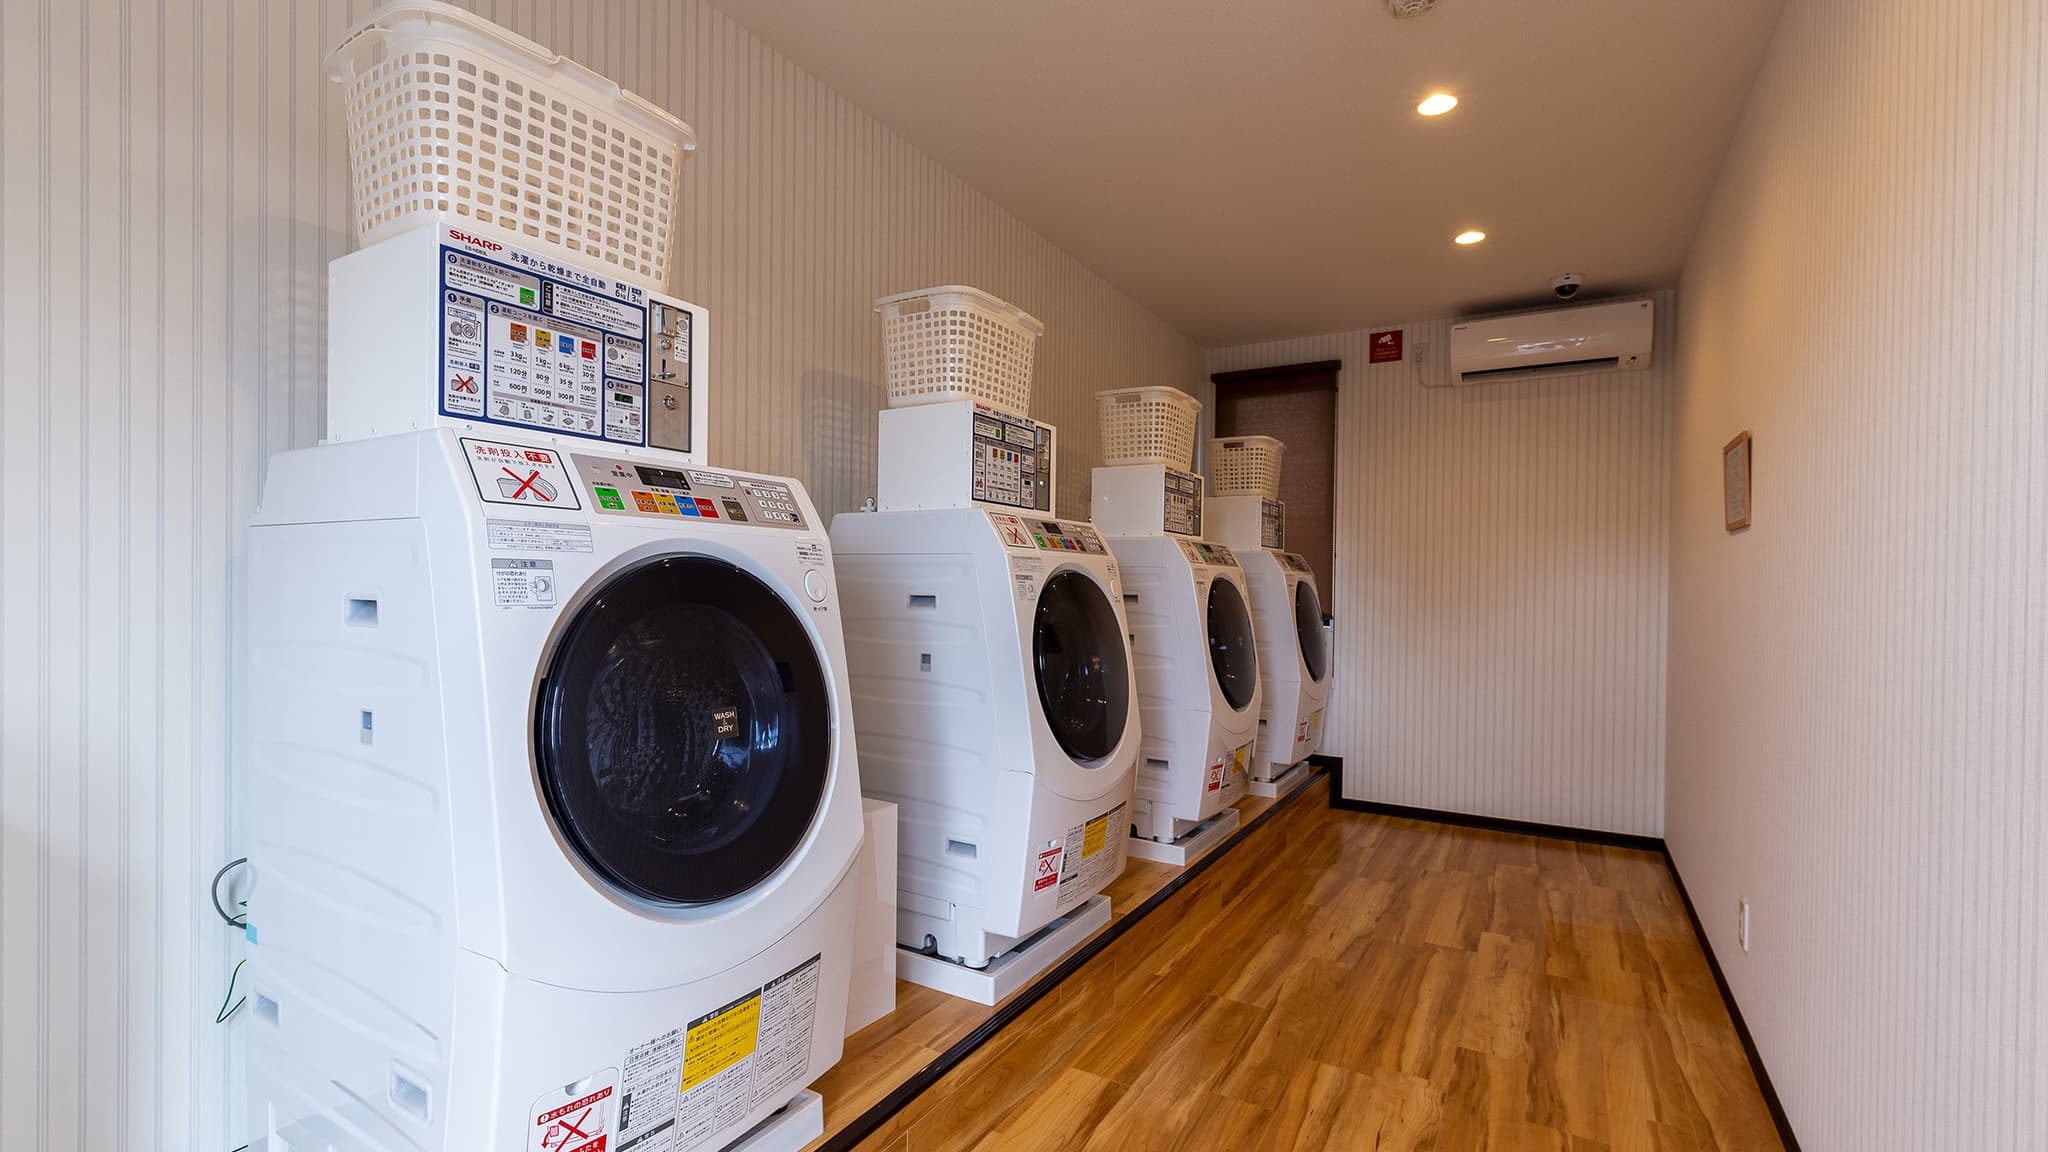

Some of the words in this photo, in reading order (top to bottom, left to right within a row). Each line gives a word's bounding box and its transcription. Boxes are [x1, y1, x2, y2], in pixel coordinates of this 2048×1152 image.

[449, 229, 503, 252] SHARP
[510, 250, 607, 290] 洗濯から乾燥まで全自動
[474, 445, 524, 459] 洗剤投入
[520, 560, 537, 568] 注意
[713, 711, 735, 721] WASH
[717, 724, 734, 734] DRY
[630, 1027, 682, 1054] オーナー様へのお願い
[550, 1088, 611, 1119] 水もれの恐れあり
